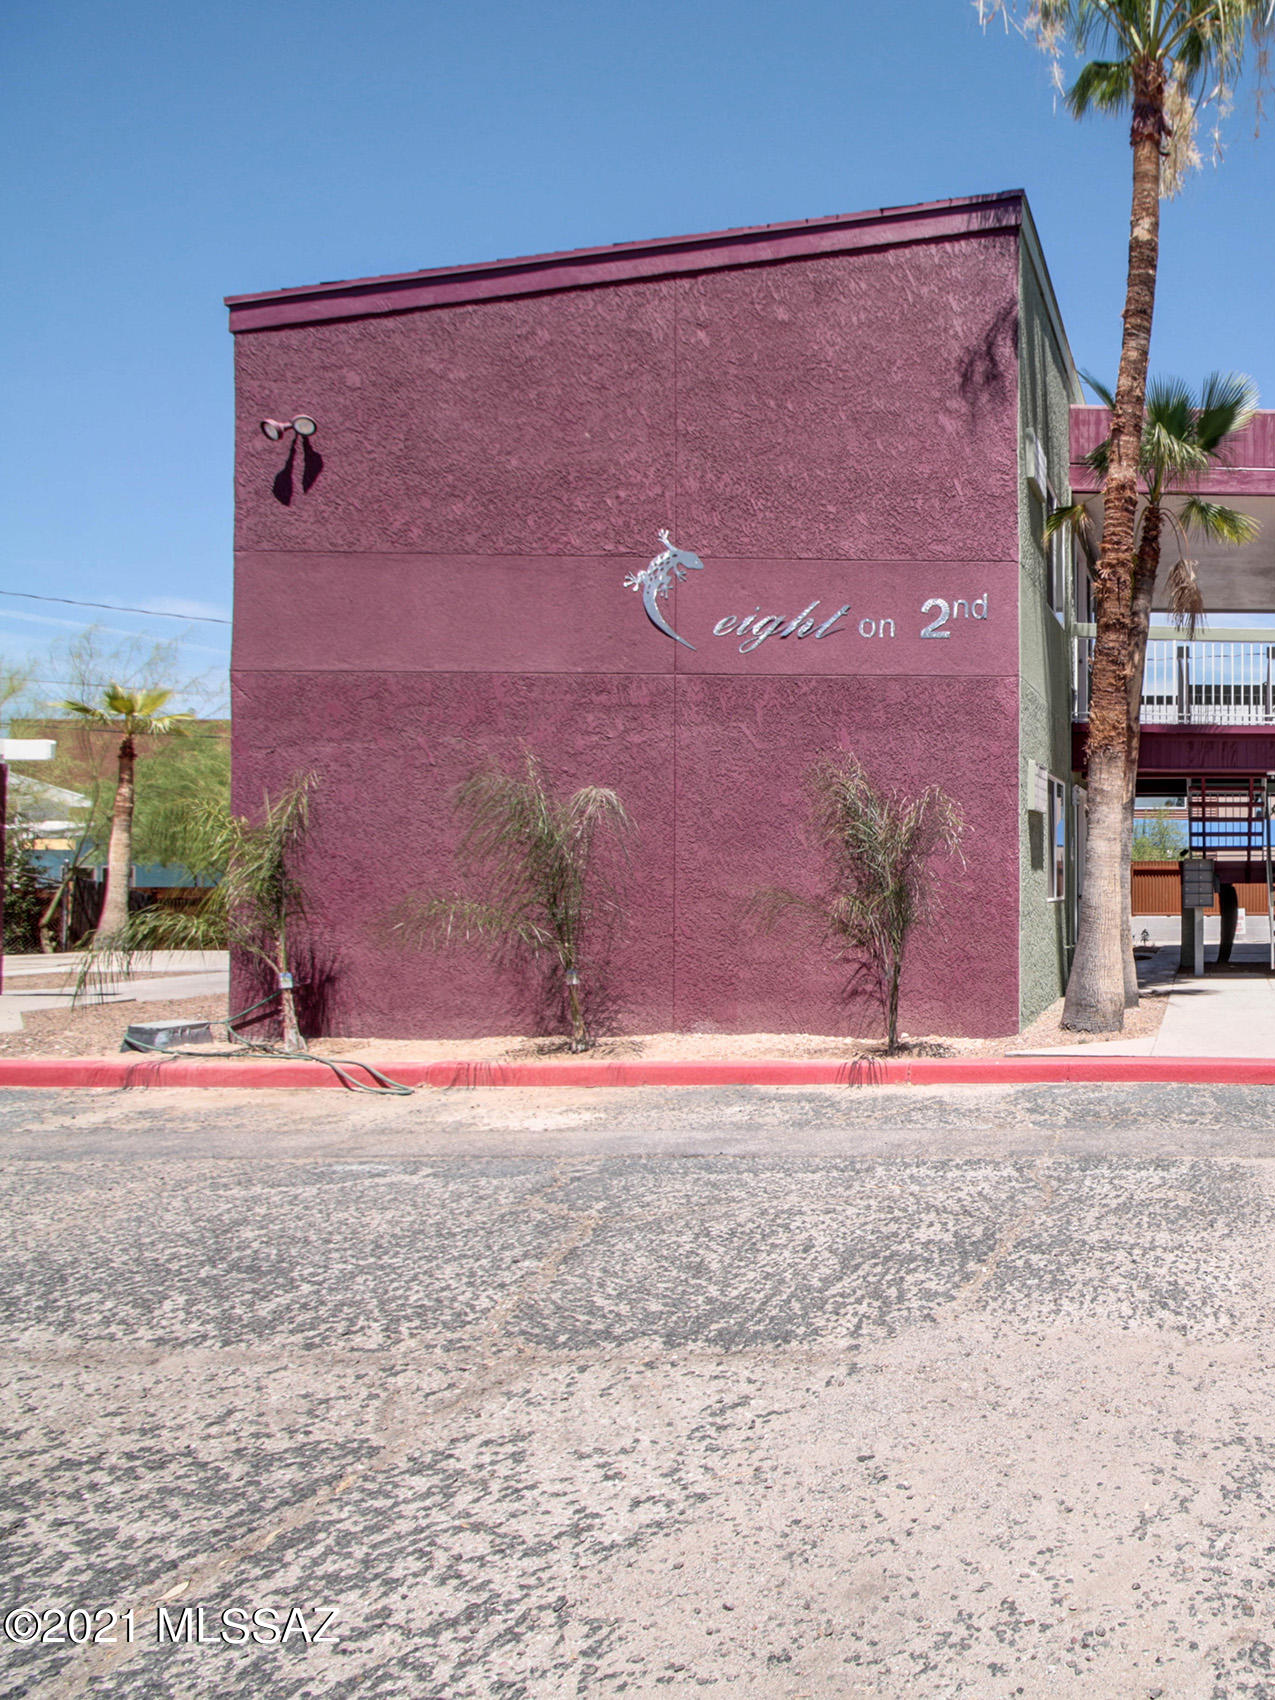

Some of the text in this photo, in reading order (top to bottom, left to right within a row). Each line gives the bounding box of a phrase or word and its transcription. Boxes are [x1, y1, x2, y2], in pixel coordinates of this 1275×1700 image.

[712, 593, 989, 654] eight on 2nd
